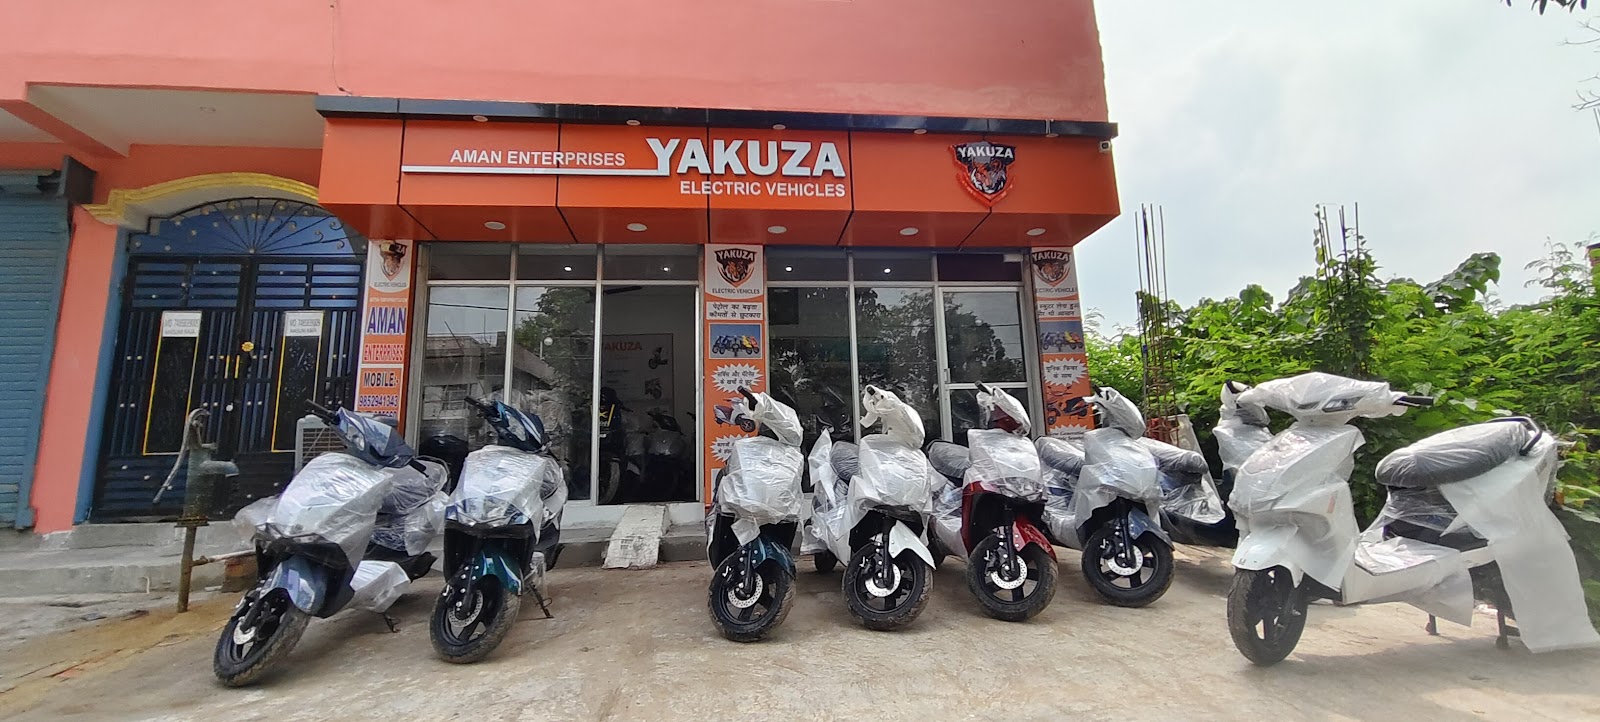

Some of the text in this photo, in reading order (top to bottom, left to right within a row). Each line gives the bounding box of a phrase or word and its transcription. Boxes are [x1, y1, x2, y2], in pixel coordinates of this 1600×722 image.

[450, 150, 626, 166] AMAN ENTERPRISES
[645, 138, 846, 177] YAKUZA
[957, 146, 1013, 159] YAKUZA
[680, 181, 846, 197] ELECTRIC VEHICLES
[717, 249, 755, 261] YAKUZA
[1031, 251, 1070, 261] YAKUZA
[367, 306, 407, 334] AMAN
[364, 344, 404, 361] ENTERPRISES
[602, 342, 642, 351] AKUZA
[363, 371, 399, 387] MOBILE:-
[359, 395, 398, 407] 9852941343
